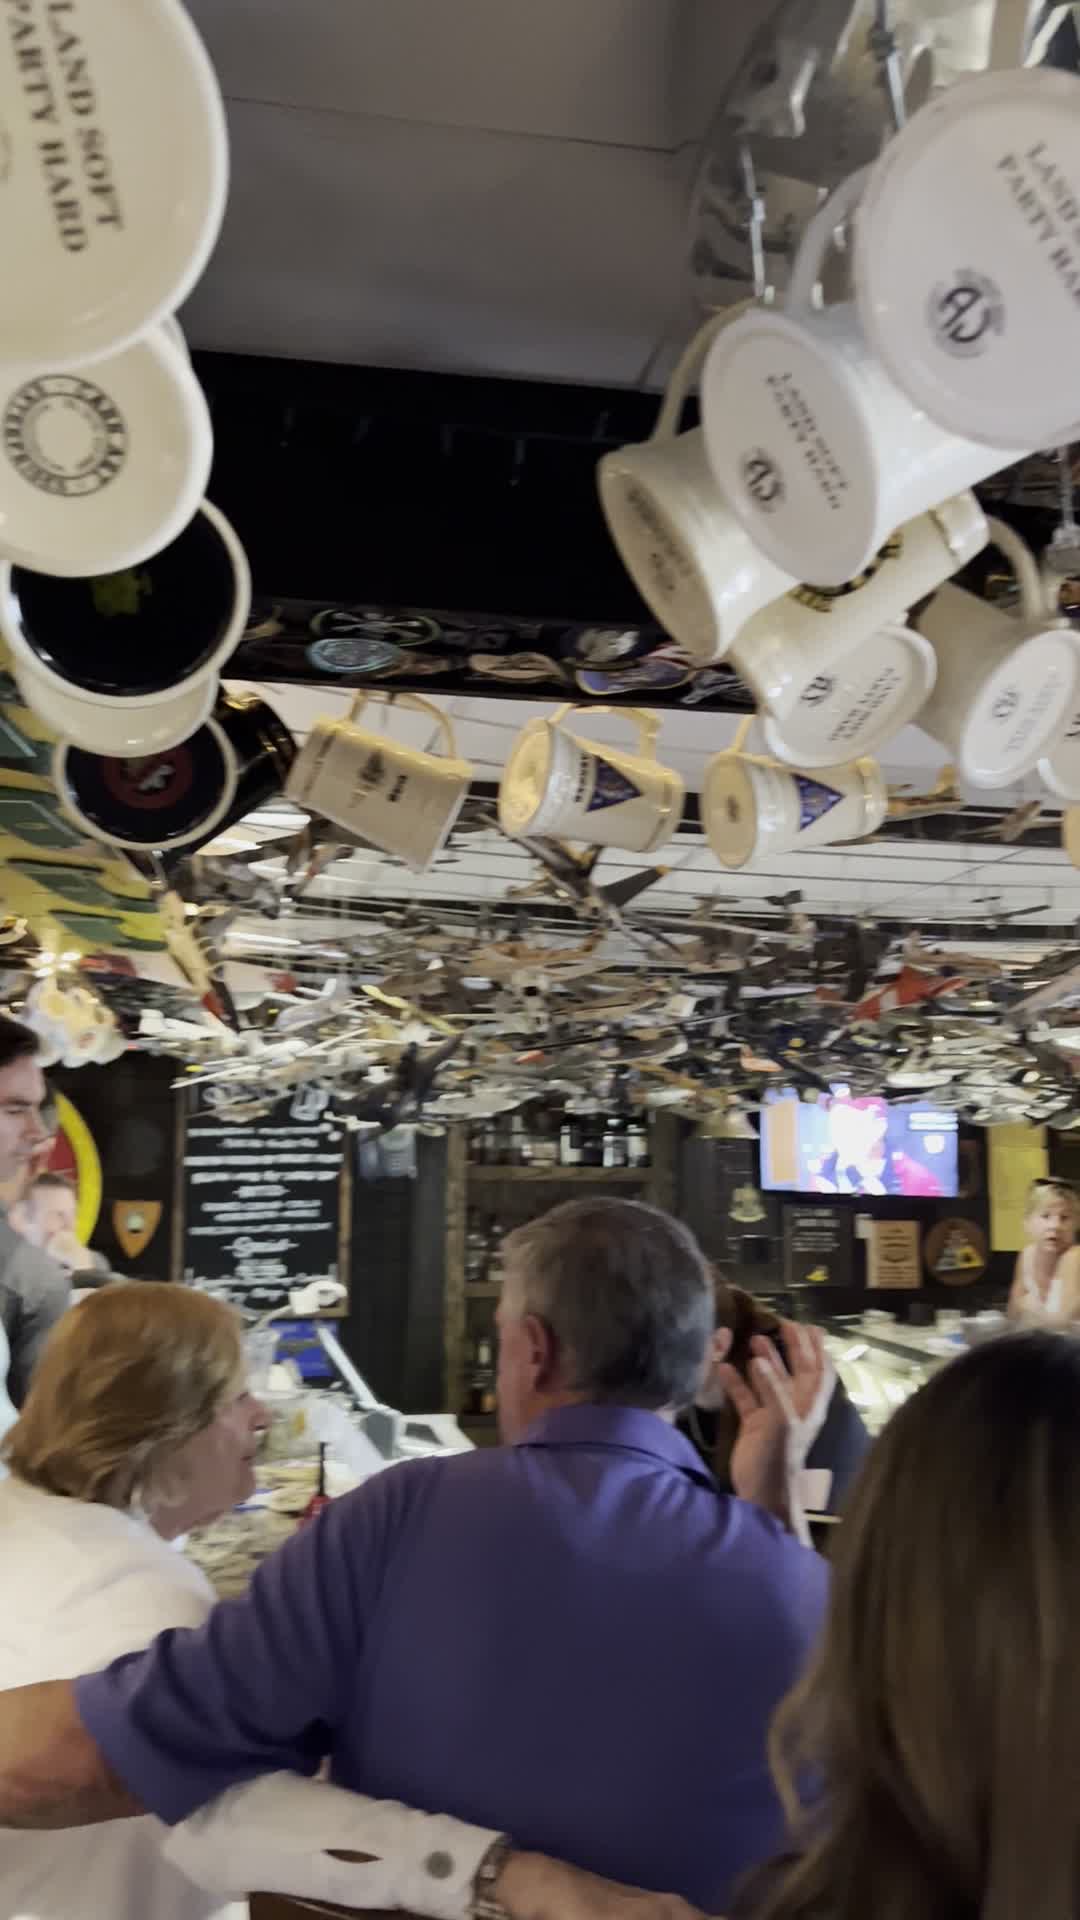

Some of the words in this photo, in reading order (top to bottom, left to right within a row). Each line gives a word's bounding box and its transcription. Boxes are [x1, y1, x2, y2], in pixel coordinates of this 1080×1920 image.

[36, 140, 92, 253] HARD
[46, 2, 97, 117] LAND
[76, 127, 126, 232] SOFT
